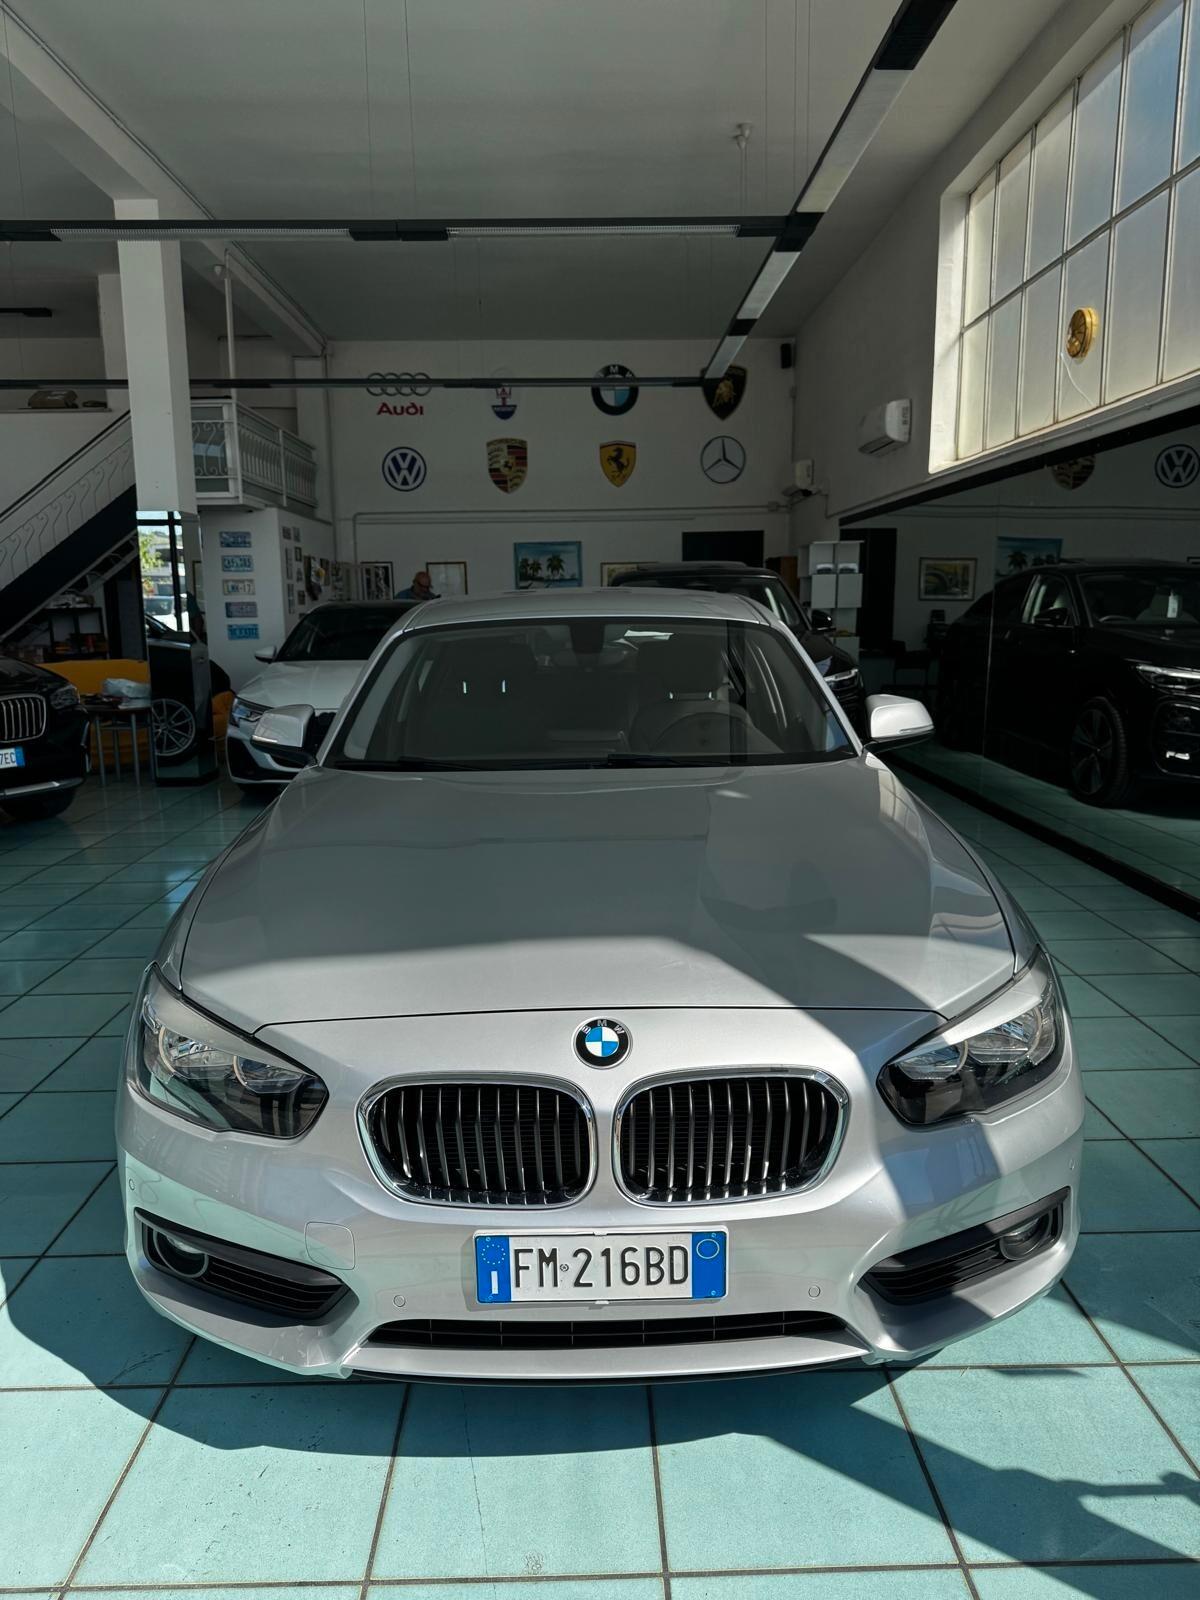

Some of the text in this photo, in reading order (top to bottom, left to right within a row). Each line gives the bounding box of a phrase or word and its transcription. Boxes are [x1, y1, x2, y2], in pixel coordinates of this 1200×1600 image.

[376, 402, 424, 416] Audi
[581, 1020, 625, 1035] BMW
[513, 1244, 690, 1289] FM 216BD
